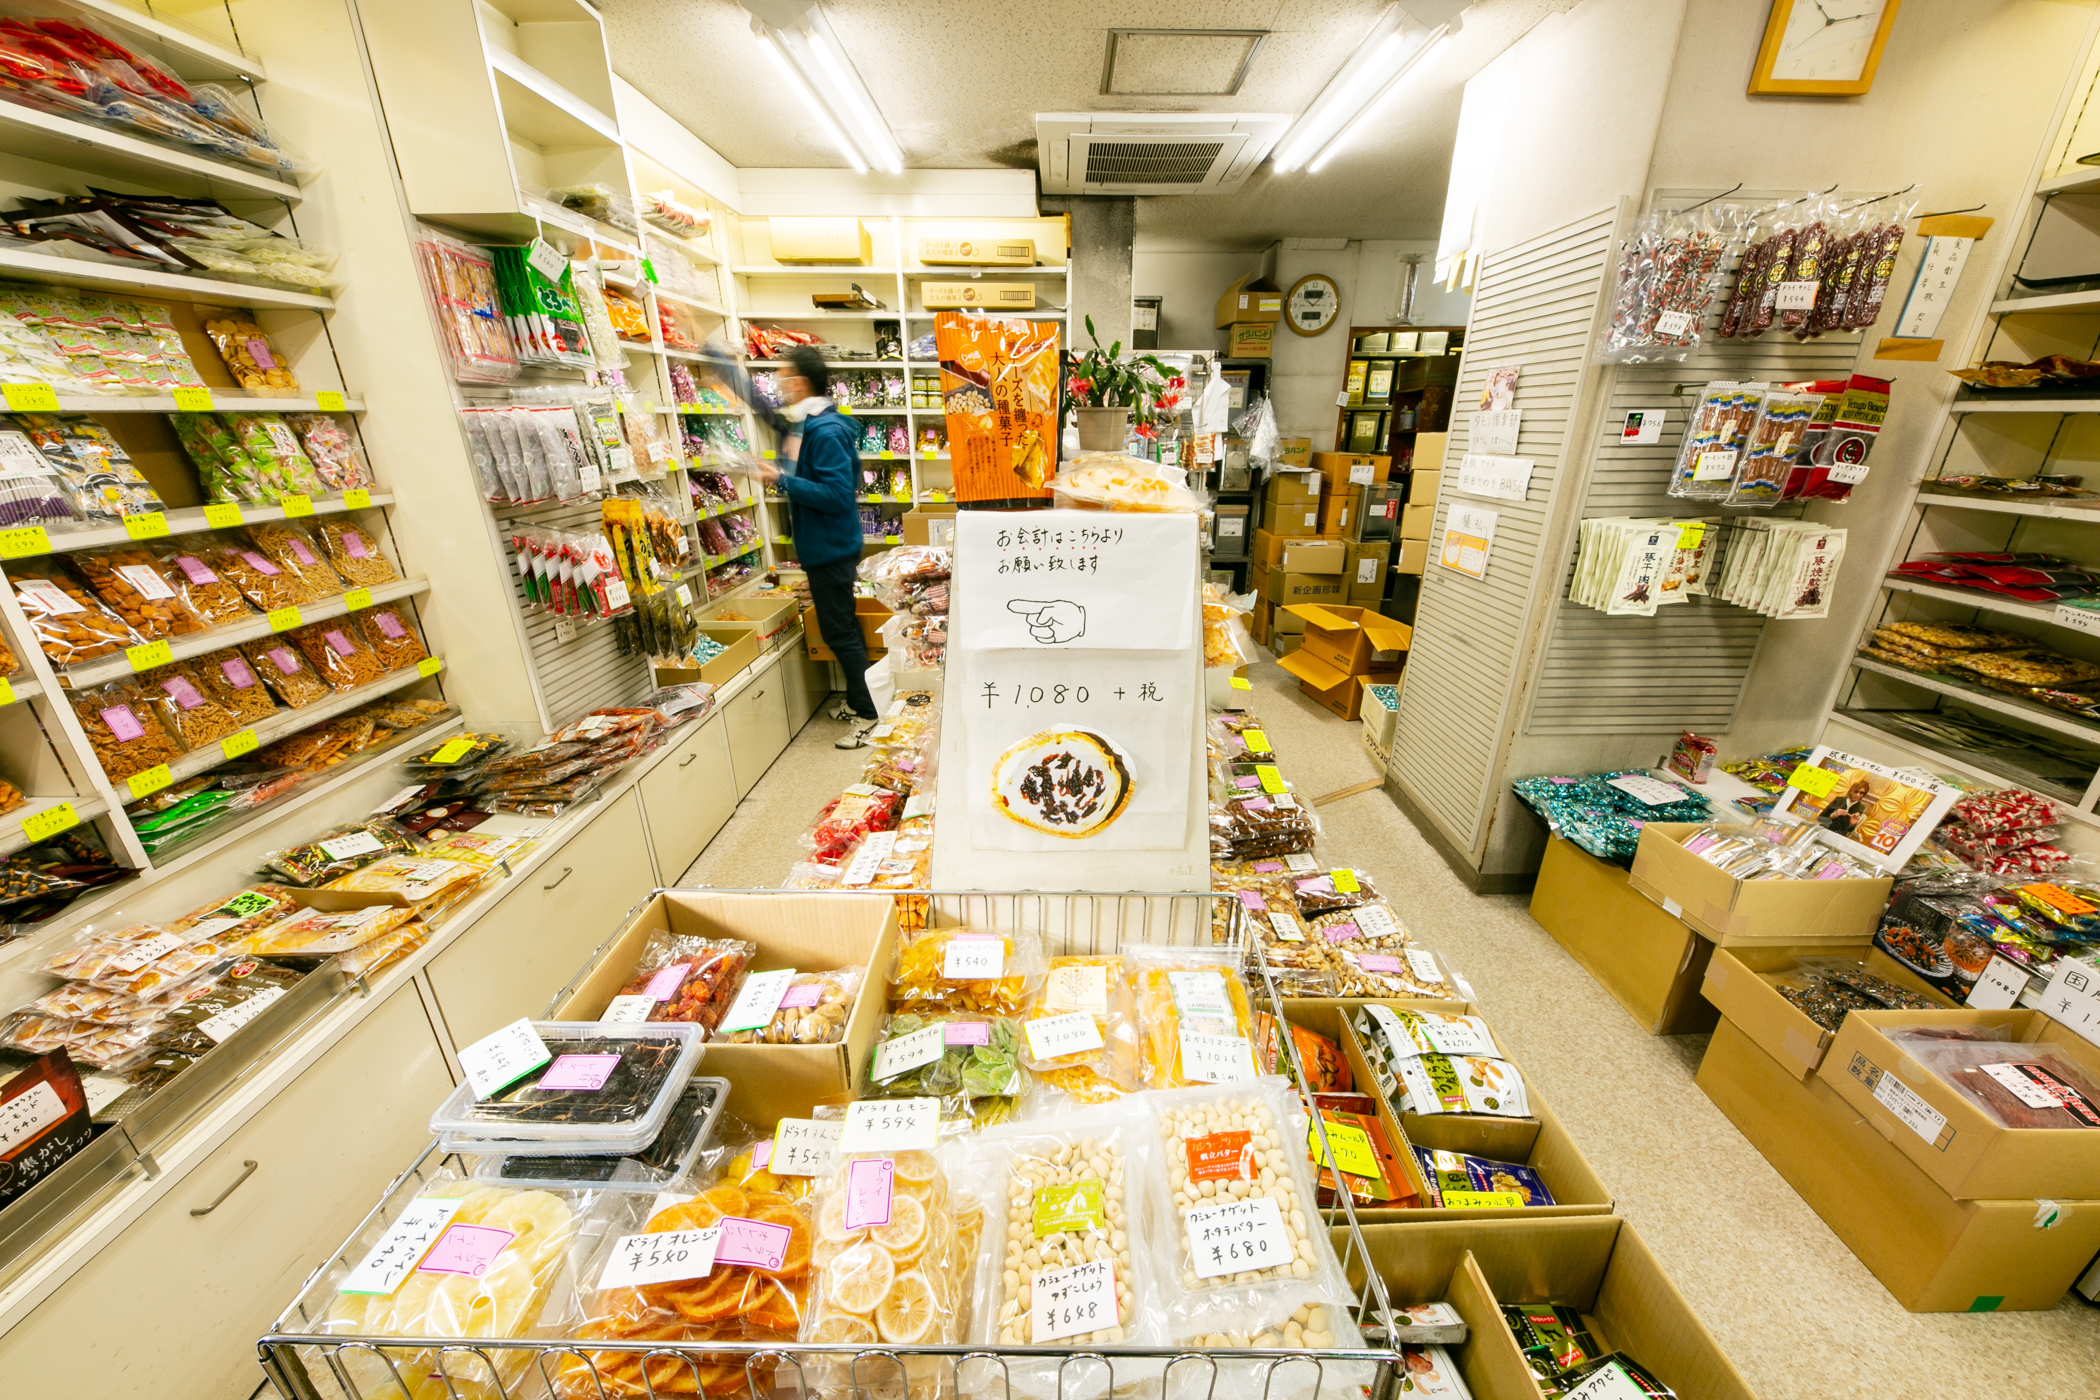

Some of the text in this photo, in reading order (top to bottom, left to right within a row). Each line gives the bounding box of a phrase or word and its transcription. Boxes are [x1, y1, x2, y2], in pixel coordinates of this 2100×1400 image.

[1788, 16, 1796, 29] 9
[1784, 41, 1792, 53] 8
[1849, 42, 1857, 54] 4
[1792, 58, 1801, 71] 7
[1808, 65, 1815, 77] 6
[1829, 59, 1837, 71] 5
[1938, 237, 1963, 290] 食品衛生
[990, 351, 1013, 447] 大人の種菓子
[1847, 398, 1888, 413] Tengu Brand
[1642, 420, 1662, 428] ¥756
[1499, 478, 1525, 494] BASE
[996, 524, 1124, 548] お会計はこちらより
[997, 554, 1099, 575] お願い致します
[1292, 585, 1341, 596] 新企画珍味
[1829, 750, 1882, 773] 欧風チーズせん
[1877, 833, 1897, 848] 10
[955, 956, 988, 968] ¥540
[1185, 1034, 1247, 1048] おかえりマンゴー
[887, 1047, 924, 1066] ¥594
[1855, 1055, 1879, 1078] 品名
[2023, 1065, 2070, 1096] DRIED
[865, 1116, 916, 1132] ¥594
[18, 1135, 70, 1175] 焦がし
[1200, 1148, 1240, 1161] 帆立バター
[370, 1216, 424, 1269] ¥540
[629, 1249, 689, 1272] ¥540
[1211, 1239, 1268, 1266] ¥680
[1038, 1262, 1107, 1289] カシューナゲット
[1051, 1278, 1103, 1302] ゆずこしょう
[1046, 1300, 1098, 1332] ¥648
